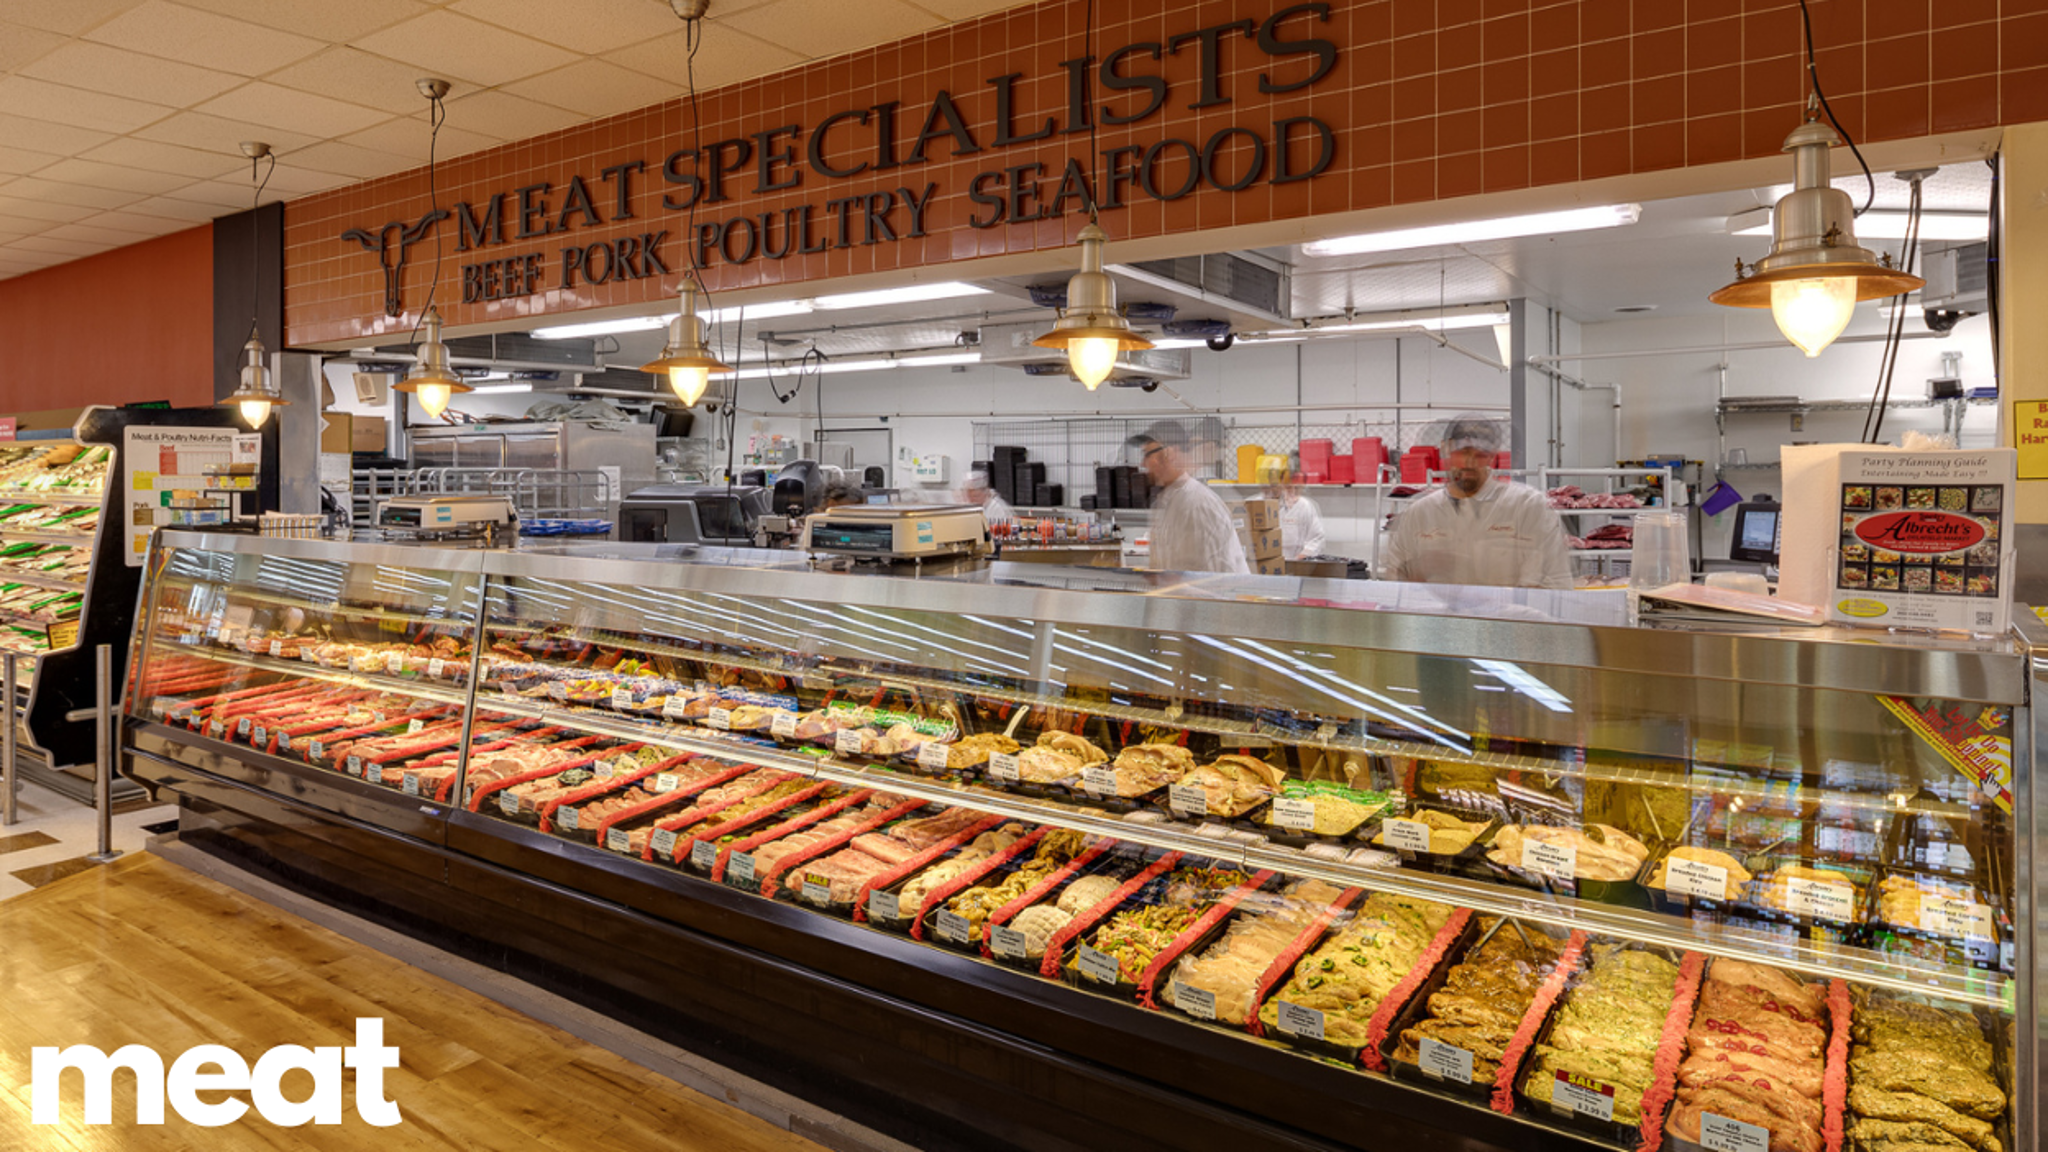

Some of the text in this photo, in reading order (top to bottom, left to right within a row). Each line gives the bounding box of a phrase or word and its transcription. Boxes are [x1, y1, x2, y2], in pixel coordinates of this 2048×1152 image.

[454, 2, 1338, 252] MEAT SPECIALISTS
[461, 116, 1337, 304] BEEF PORK POULTRY SEAFOOD
[131, 432, 153, 441] Meat
[161, 434, 188, 443] Poultry
[1862, 456, 1988, 470] Party Planning Guide
[1861, 470, 1921, 479] Entertaining
[1952, 470, 1976, 479] Easy
[1863, 515, 1971, 541] Albrecht's
[1923, 705, 2002, 774] Your Shopping!
[1947, 706, 2000, 754] Let Us Do
[807, 873, 828, 885] SALE
[1568, 1074, 1603, 1093] SALE
